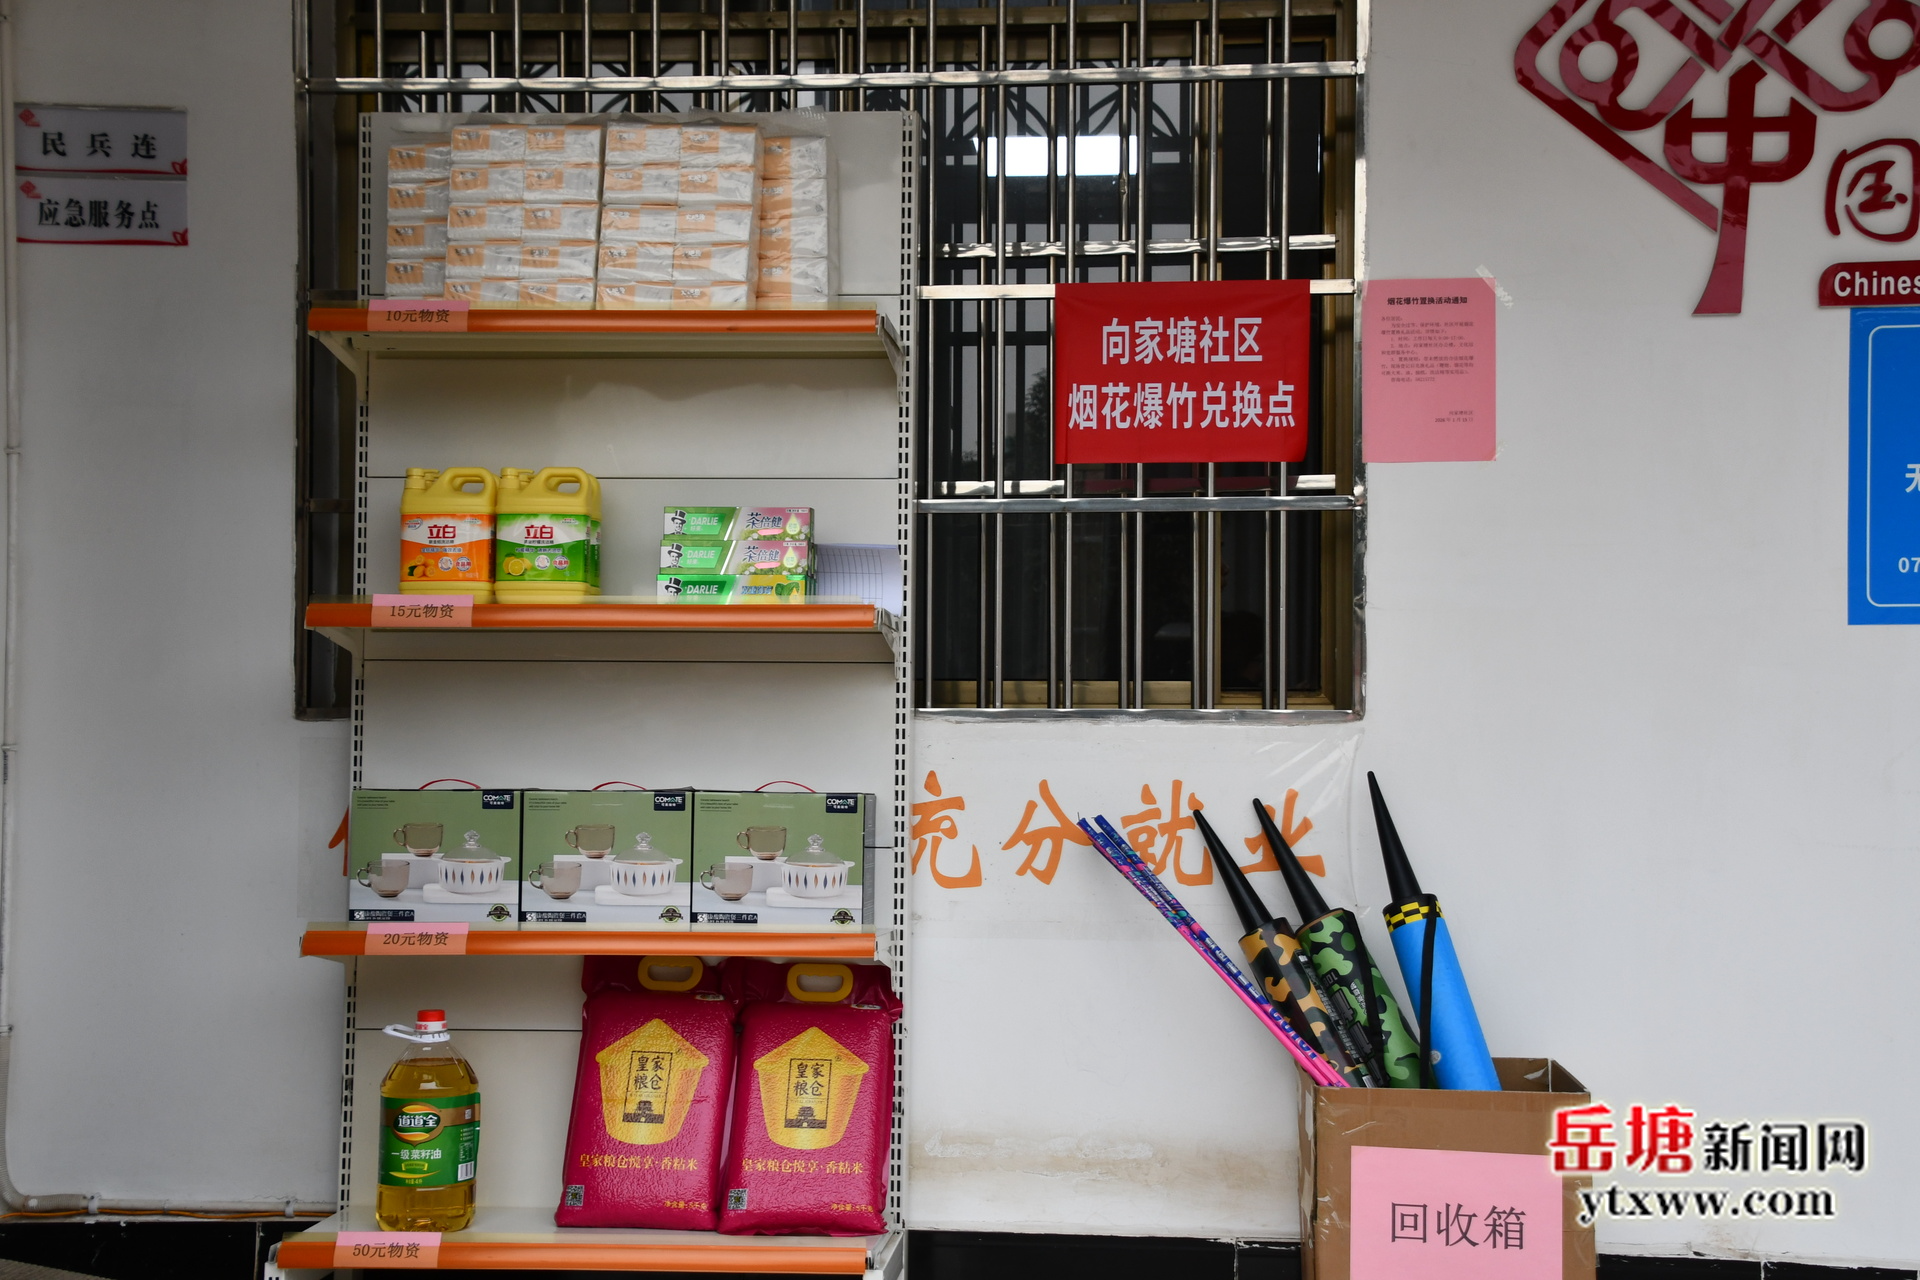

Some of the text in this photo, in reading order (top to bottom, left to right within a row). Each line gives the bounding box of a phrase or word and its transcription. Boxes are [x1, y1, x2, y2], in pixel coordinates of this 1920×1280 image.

[42, 131, 156, 158] 民兵连
[38, 198, 159, 228] 应急服务点
[386, 309, 450, 323] 10元物资
[1102, 316, 1263, 365] 向家塘社区
[1068, 380, 1296, 430] 烟花爆竹兑换点
[690, 517, 719, 526] DARLIE
[746, 512, 783, 529] 茶倍健
[427, 525, 456, 539] 立白
[524, 525, 554, 540] 立白
[687, 550, 716, 559] DARLIE
[743, 546, 780, 562] 茶倍健
[686, 585, 719, 594] DARLIE
[390, 604, 454, 618] 15元物资
[383, 932, 449, 946] 20元物资
[636, 1055, 665, 1072] 皇家
[796, 1062, 825, 1079] 皇家
[634, 1073, 663, 1090] 粮仓
[793, 1080, 824, 1096] 粮仓
[398, 1115, 437, 1127] 道道全
[391, 1149, 442, 1160] 一级菜籽油
[1391, 1202, 1527, 1250] 回收箱
[353, 1242, 420, 1258] 50元物资
